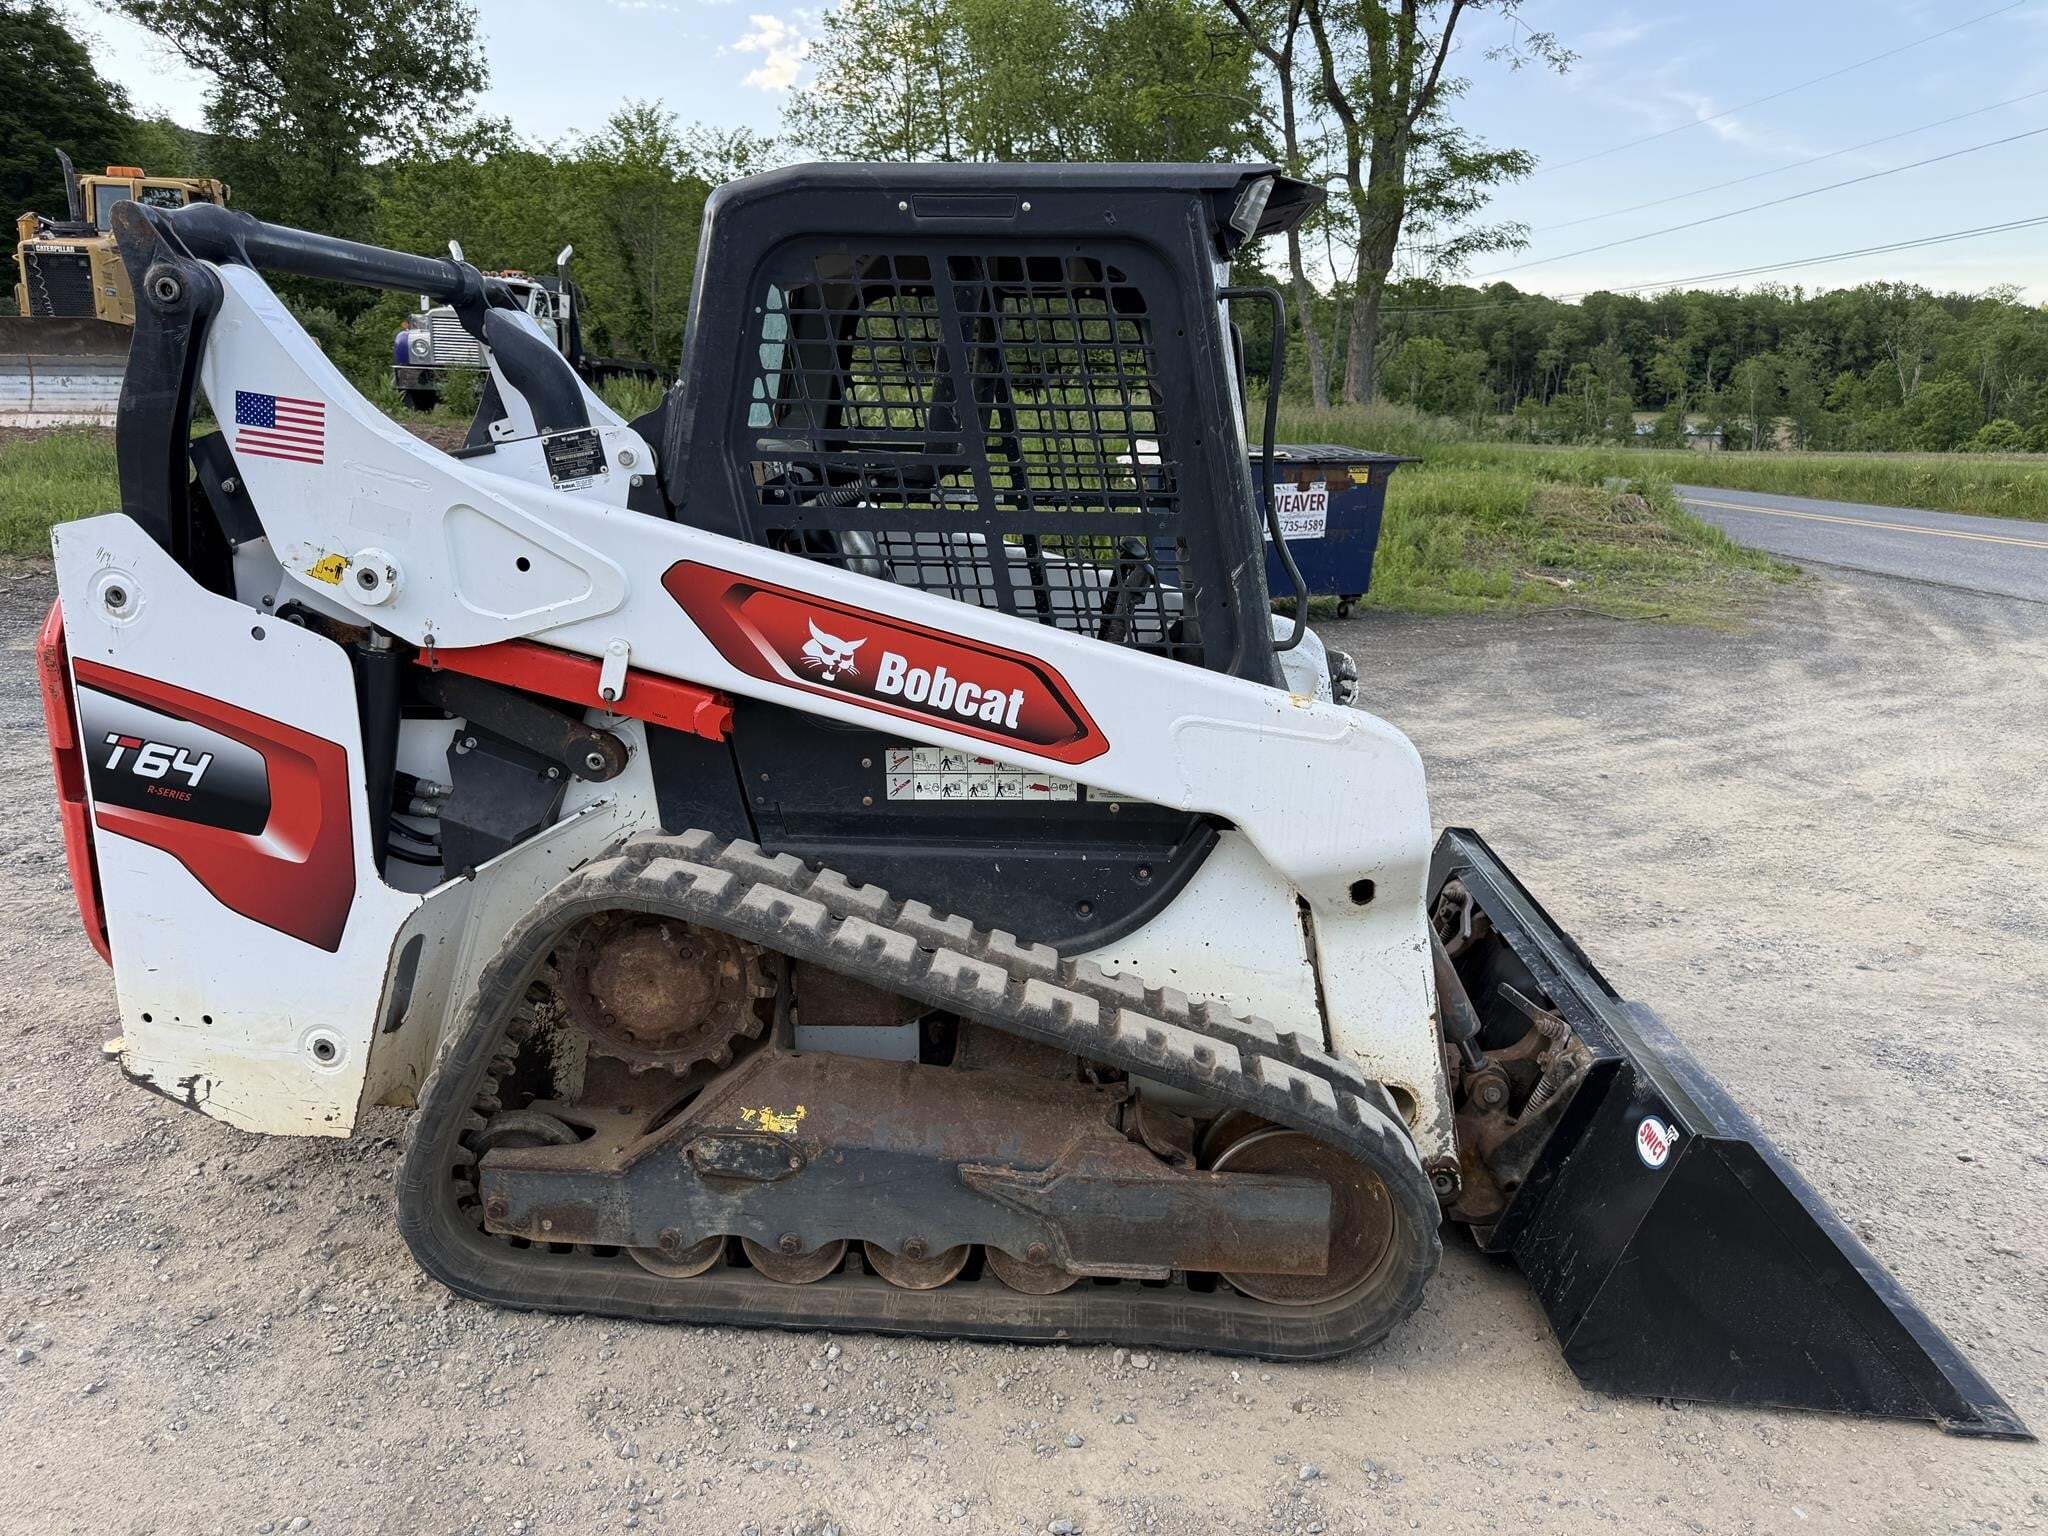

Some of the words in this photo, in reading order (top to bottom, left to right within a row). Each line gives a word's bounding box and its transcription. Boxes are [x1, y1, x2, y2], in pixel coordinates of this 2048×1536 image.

[35, 244, 75, 253] CATERPILLAR
[1279, 519, 1324, 532] -735-4589
[874, 651, 1025, 730] Bobcat
[104, 732, 214, 787] T64
[147, 785, 193, 802] R-SERIES
[1640, 1122, 1666, 1161] SWICT
